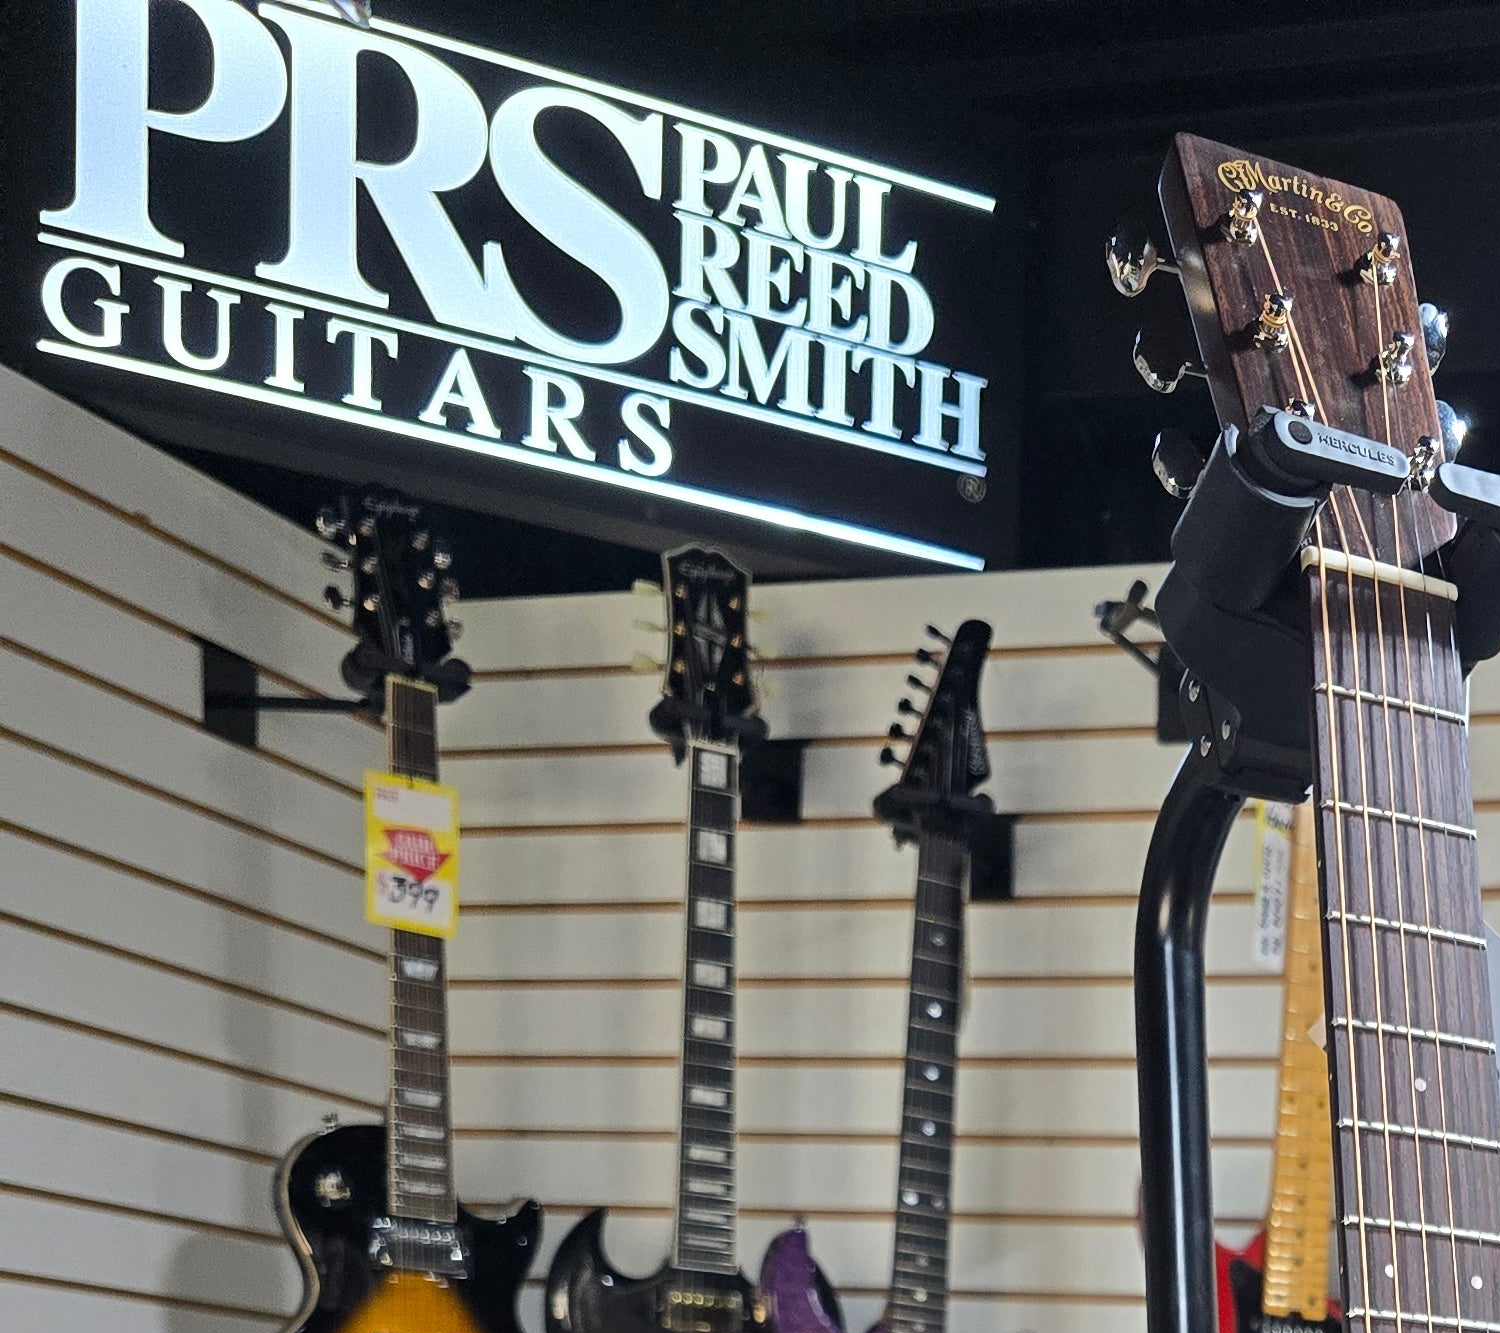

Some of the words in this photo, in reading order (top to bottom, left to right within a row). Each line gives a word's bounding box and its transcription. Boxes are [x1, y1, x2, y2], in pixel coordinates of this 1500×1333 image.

[39, 0, 669, 365] PRS
[673, 122, 917, 273] PAUL
[672, 211, 936, 356] REED
[40, 255, 674, 477] GUITARS
[669, 296, 988, 460] SMITH
[1317, 432, 1396, 467] HERCULES
